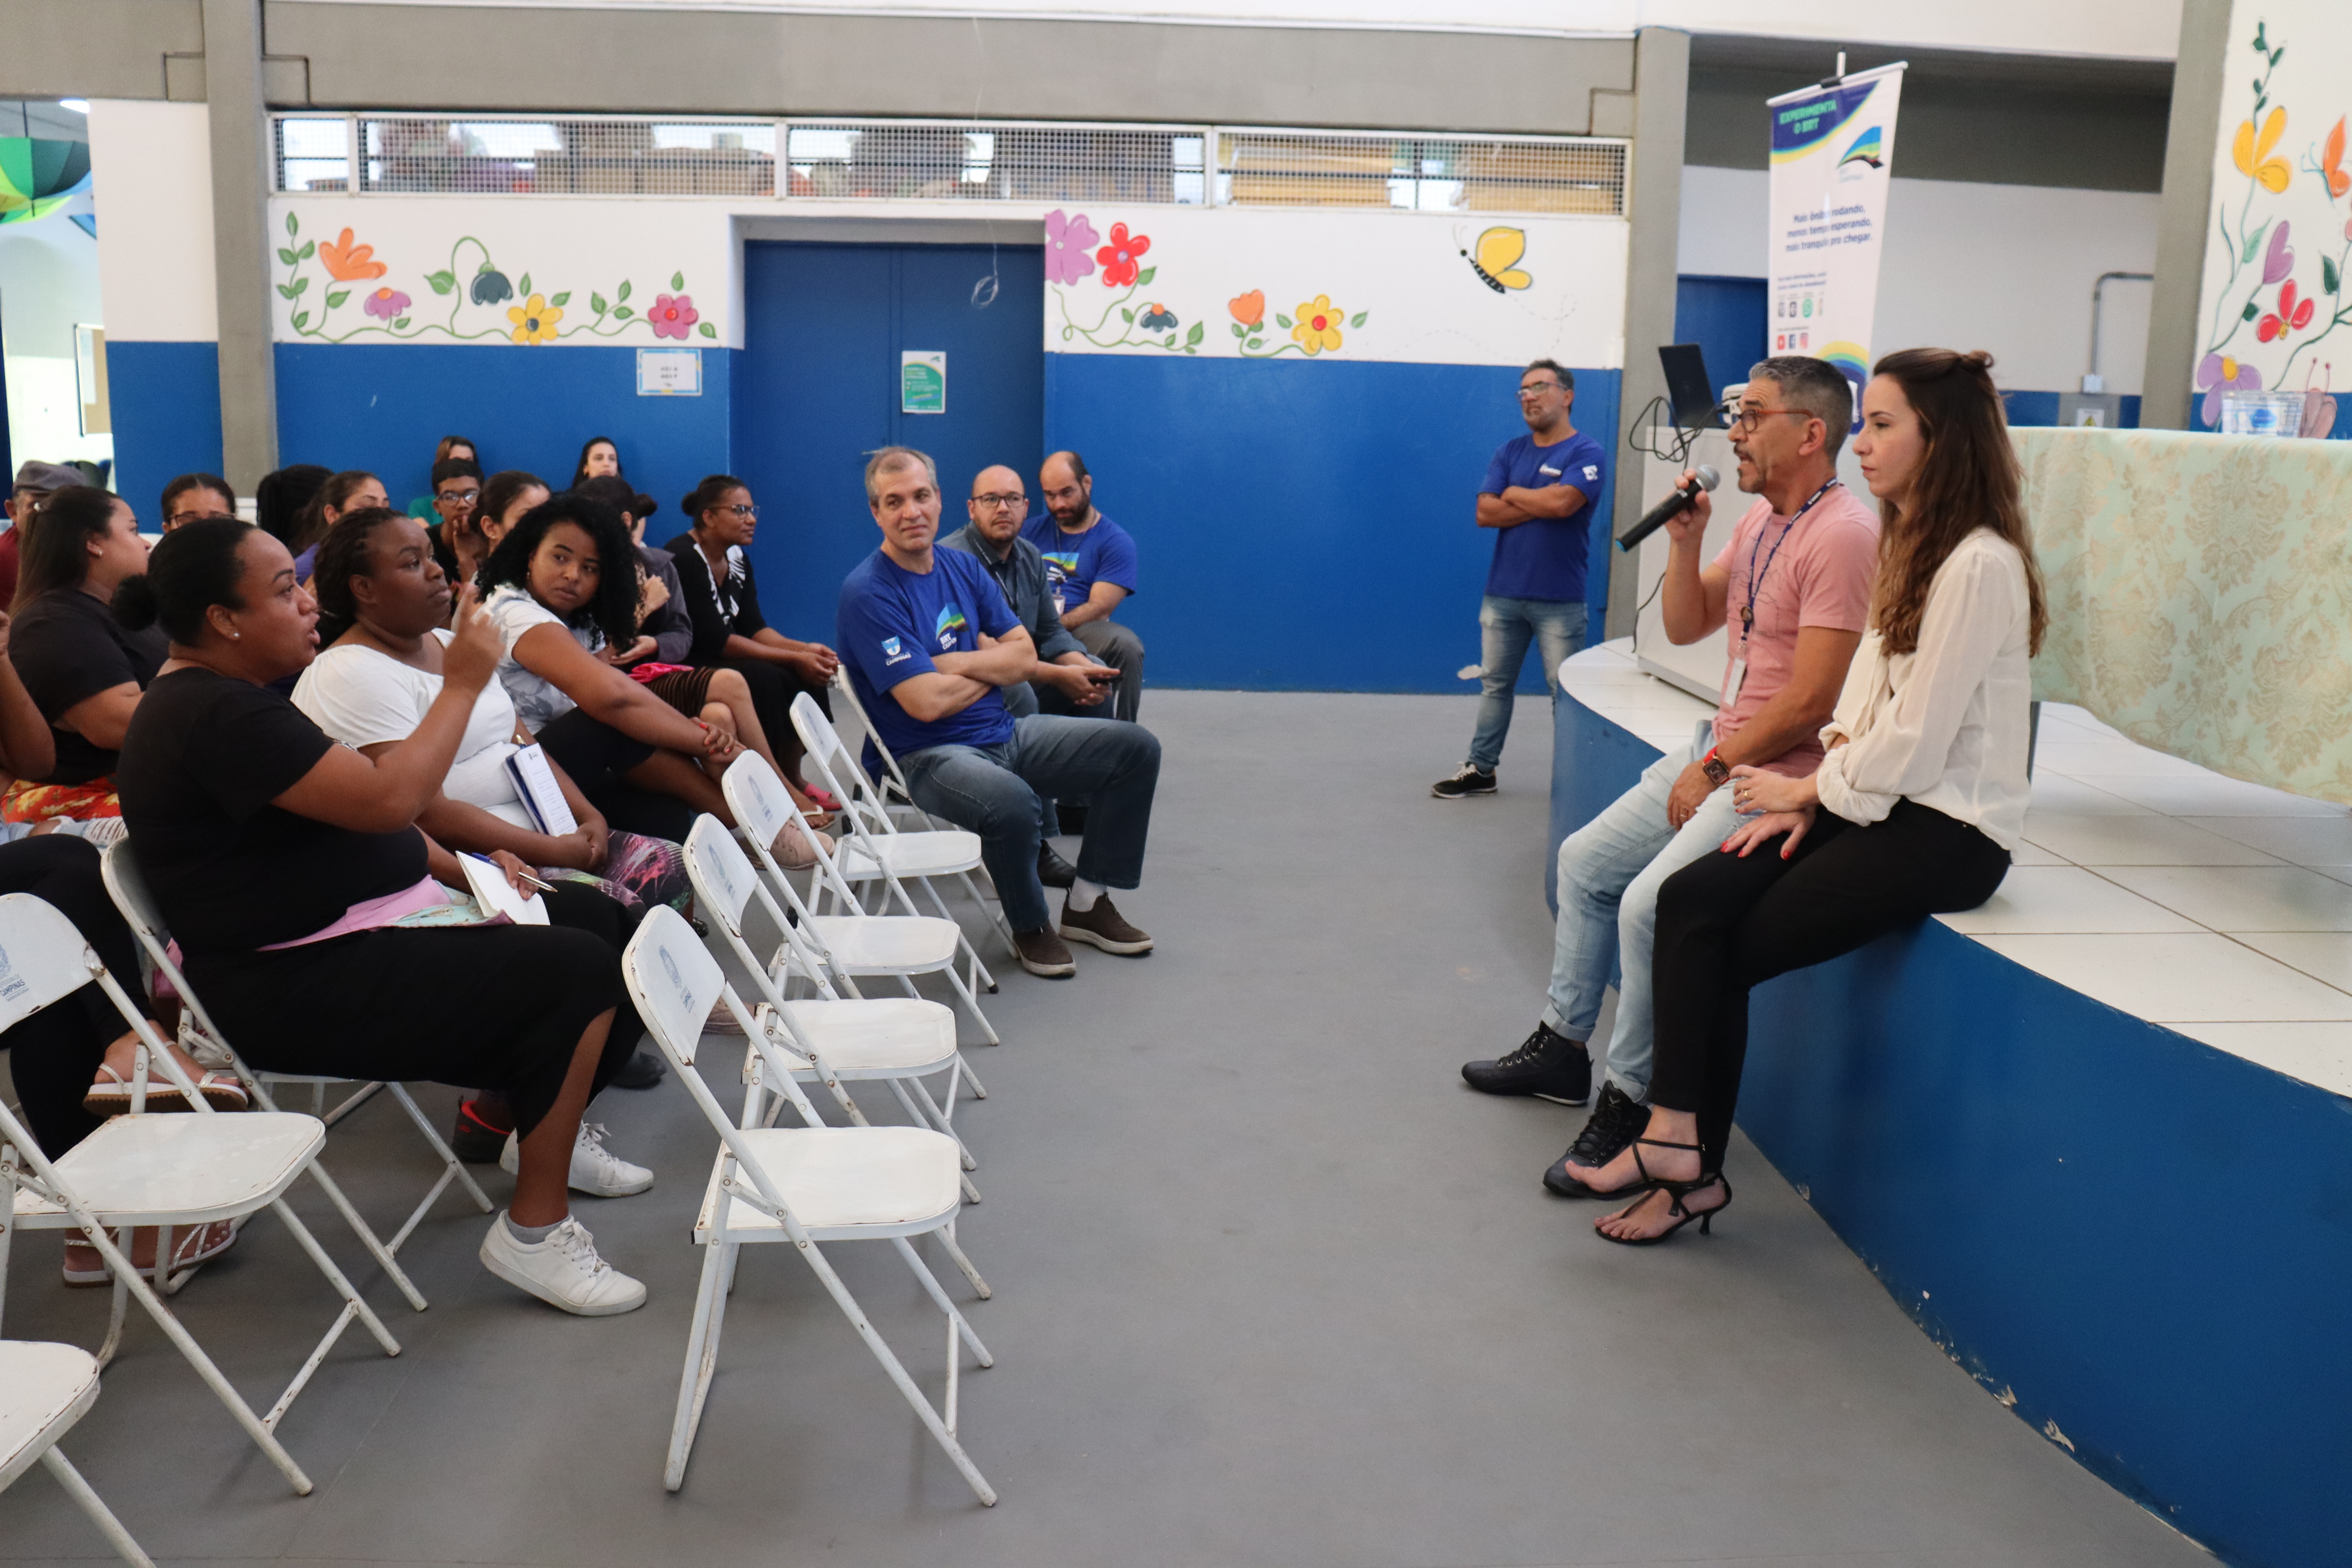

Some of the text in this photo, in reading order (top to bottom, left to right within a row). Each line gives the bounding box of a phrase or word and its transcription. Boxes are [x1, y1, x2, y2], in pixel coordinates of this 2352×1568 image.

[1794, 204, 1866, 223] Mais ônib rodando,
[942, 637, 957, 650] CAMPIN
